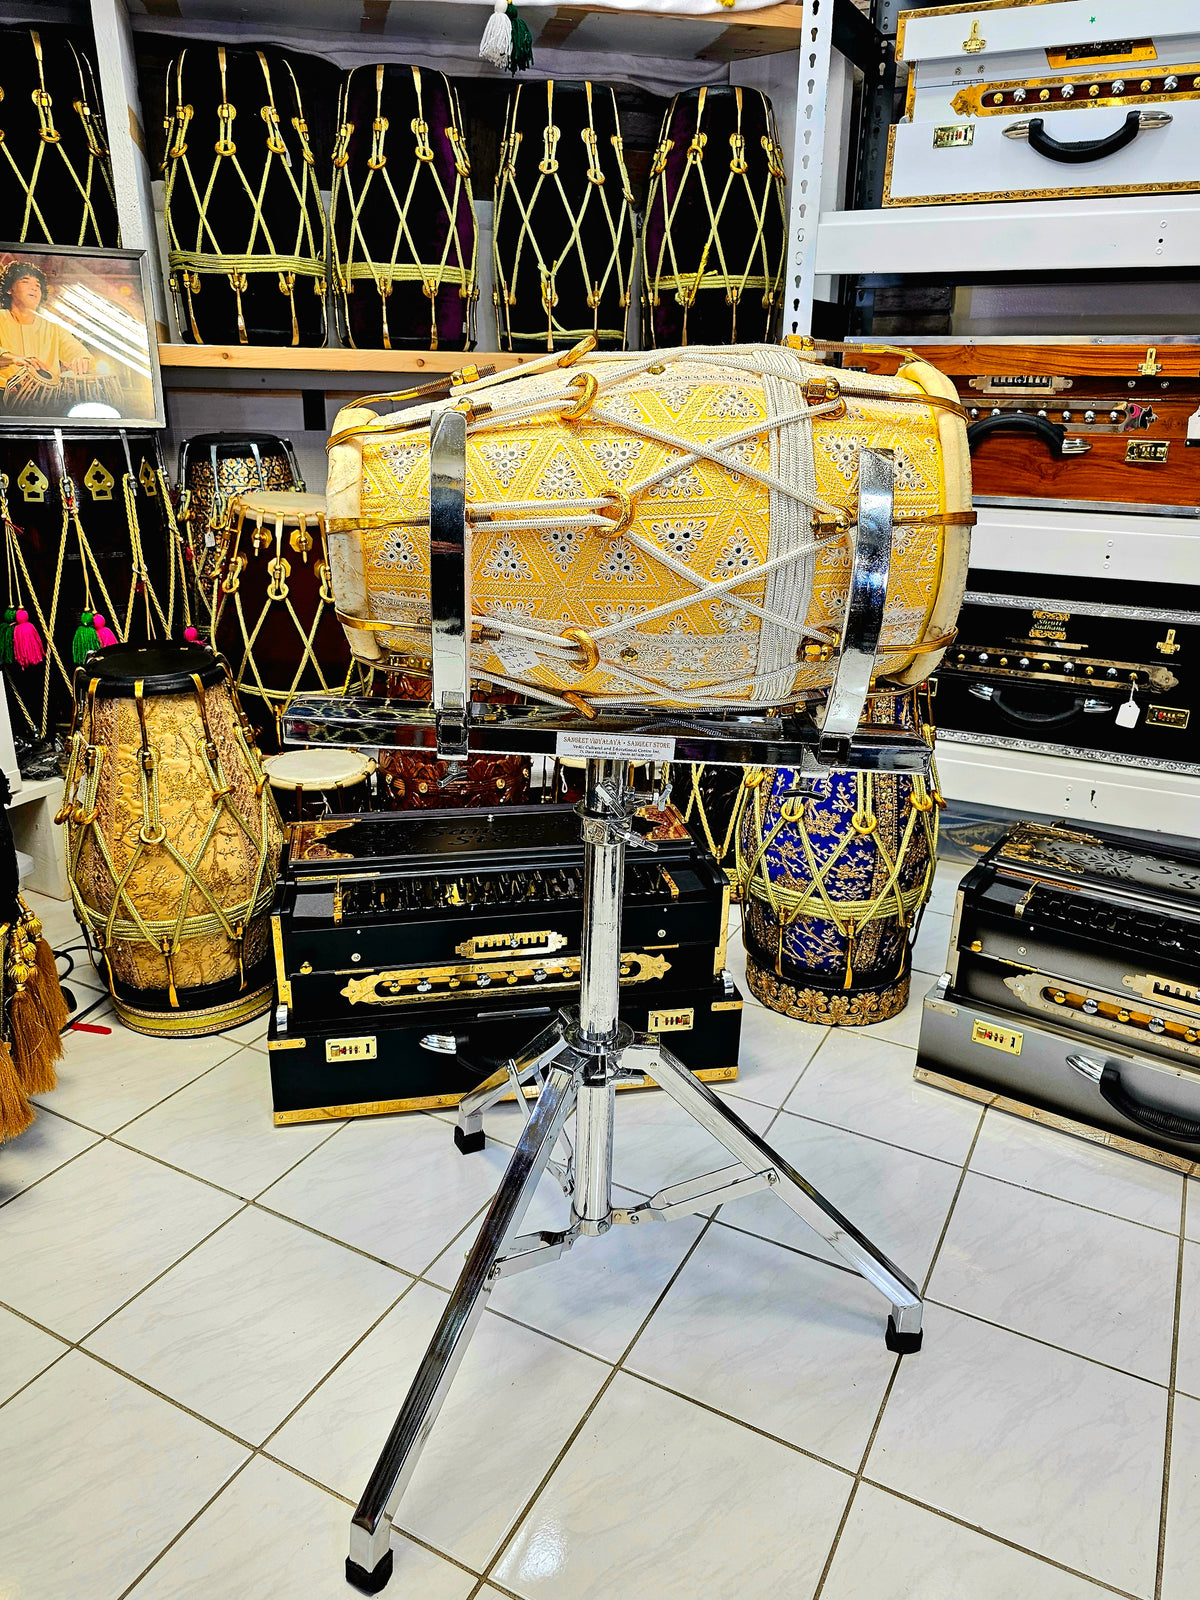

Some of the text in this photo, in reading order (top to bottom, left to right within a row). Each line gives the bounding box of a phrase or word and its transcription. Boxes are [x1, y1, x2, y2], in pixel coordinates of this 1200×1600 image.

[1038, 619, 1063, 627] Shruti
[1032, 624, 1066, 632] Sadhana
[563, 736, 588, 744] SANGEET
[590, 737, 621, 746] VIDYALAYA
